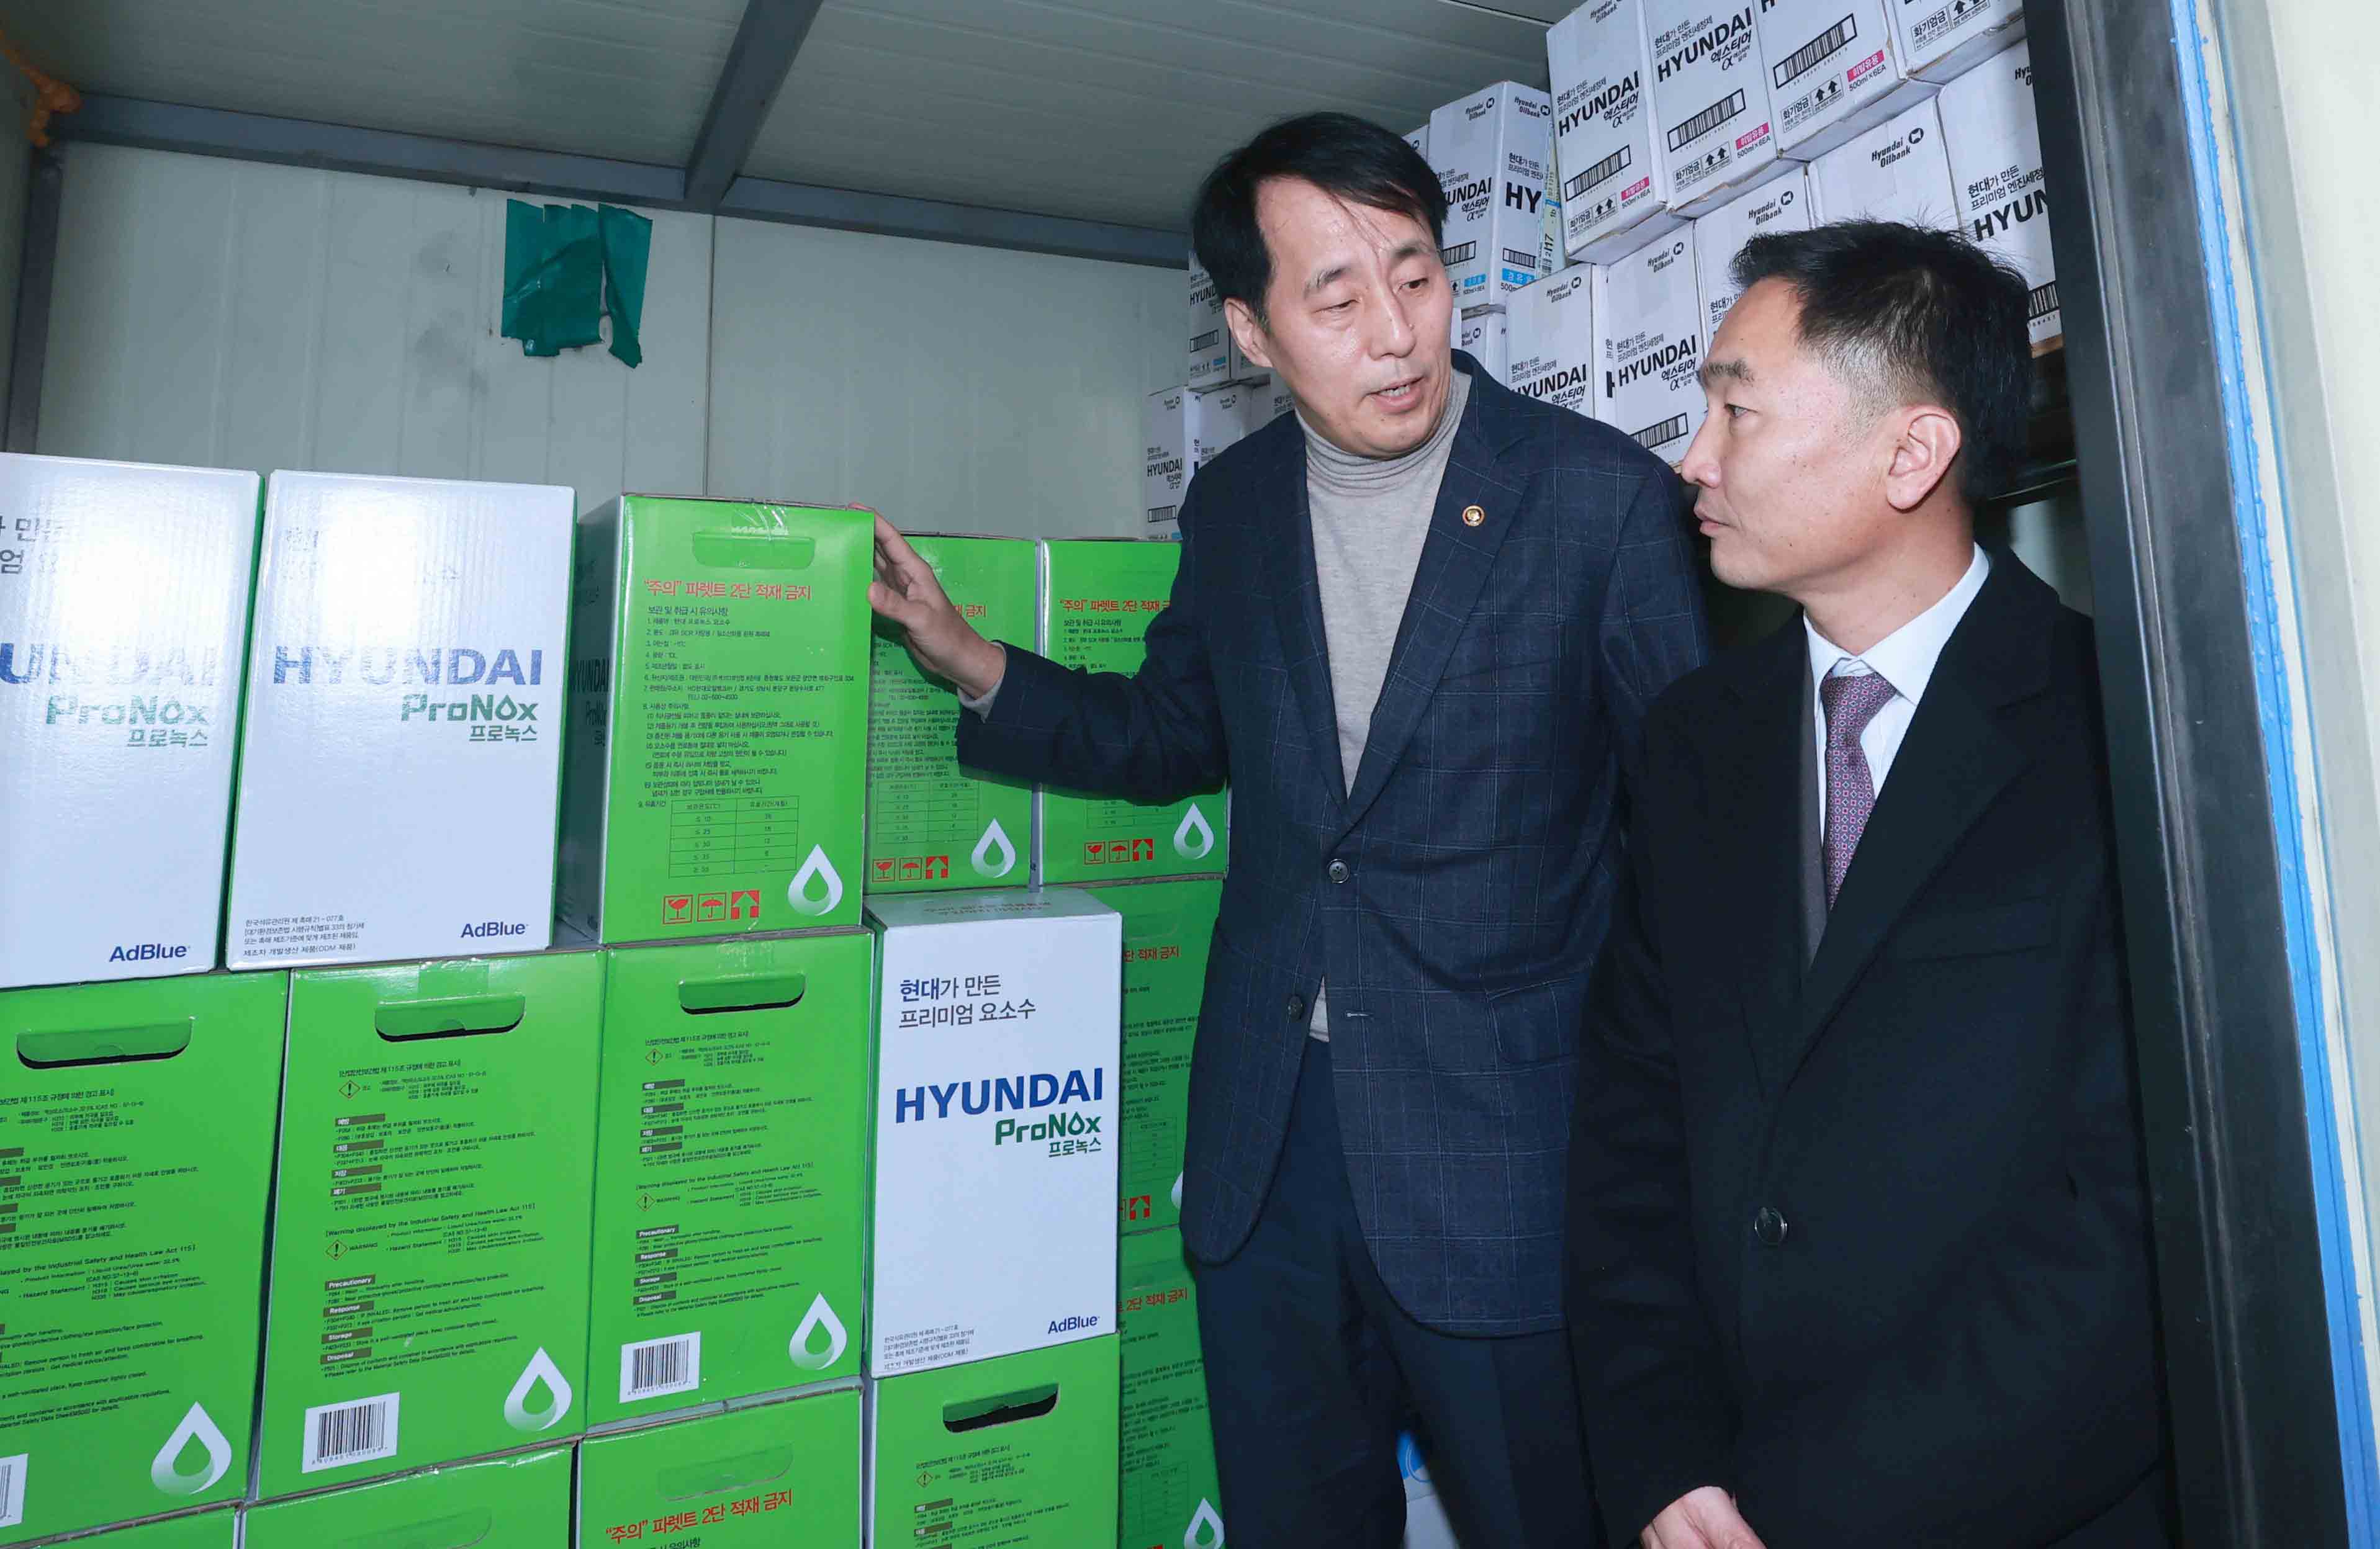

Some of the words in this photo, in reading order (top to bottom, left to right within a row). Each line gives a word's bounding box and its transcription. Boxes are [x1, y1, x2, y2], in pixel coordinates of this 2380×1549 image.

[1914, 10, 1947, 38] 화기엄금
[1654, 24, 1677, 49] 현대가
[1677, 19, 1690, 34] 만든
[1657, 7, 1752, 83] HYUNDAI
[1514, 96, 1538, 110] Hyundai
[1559, 70, 1639, 137] HYUNDAI
[1783, 97, 1809, 120] 화기엄금
[1872, 136, 1903, 162] Hyundai
[1880, 145, 1911, 168] Oilbank
[1445, 177, 1492, 206] UNDAI
[1967, 177, 2001, 200] 현대가
[2001, 164, 2020, 182] 만든
[1971, 188, 2007, 212] 프리미엄
[2007, 166, 2045, 195] 엔진세정
[1749, 199, 1776, 219] Hyundai
[1756, 206, 1783, 225] Oilbank
[1973, 189, 2049, 243] HYUN
[1648, 248, 1670, 267] Hyundai
[1710, 297, 1733, 313] 현대가
[1616, 338, 1635, 353] 현대가
[1618, 334, 1697, 387] HYUNDAI
[1516, 364, 1586, 398] YUNDAI
[1147, 458, 1183, 477] HYUNDAI
[685, 581, 726, 598] 파렛트
[730, 583, 751, 599] 2단
[755, 584, 782, 601] 적재
[784, 585, 811, 601] 금지
[700, 606, 728, 617] 유의사항
[965, 603, 987, 617] 금지
[1091, 599, 1120, 613] 파렛트
[1122, 600, 1138, 613] 2단
[1141, 599, 1160, 613] 적재
[127, 729, 208, 748] 프로녹스
[470, 725, 538, 743] 프로녹스
[461, 921, 526, 940] AdBlue
[109, 943, 188, 962] AdBlue
[1124, 948, 1135, 963] 단
[1138, 948, 1158, 961] 적재
[1161, 945, 1179, 959] 금지
[900, 977, 960, 1002] 현대가
[965, 975, 1001, 997] 만든
[899, 1003, 973, 1028] 프리미엄
[979, 999, 1037, 1022] 요소수
[896, 1067, 1103, 1124] HYUNDAI
[1048, 1137, 1102, 1157] 프로녹스
[441, 1214, 460, 1224] Safety
[476, 1210, 495, 1218] Health
[639, 1227, 676, 1237] Precautionary
[49, 1260, 83, 1270] Industrial
[84, 1257, 107, 1267] Safety
[109, 1254, 123, 1262] and
[125, 1250, 148, 1260] Health
[150, 1249, 163, 1257] Law
[166, 1247, 178, 1255] Act
[641, 1252, 667, 1260] Response
[329, 1277, 372, 1288] Precautionary
[639, 1293, 662, 1303] Disposal
[330, 1304, 361, 1314] Response
[1048, 1316, 1098, 1334] AdBlue
[328, 1332, 353, 1342] Storage
[327, 1352, 355, 1362] Disposal
[652, 1511, 698, 1534] 파렛트
[701, 1502, 726, 1525] 2단
[729, 1495, 759, 1517] 적재
[763, 1488, 793, 1512] 금지
